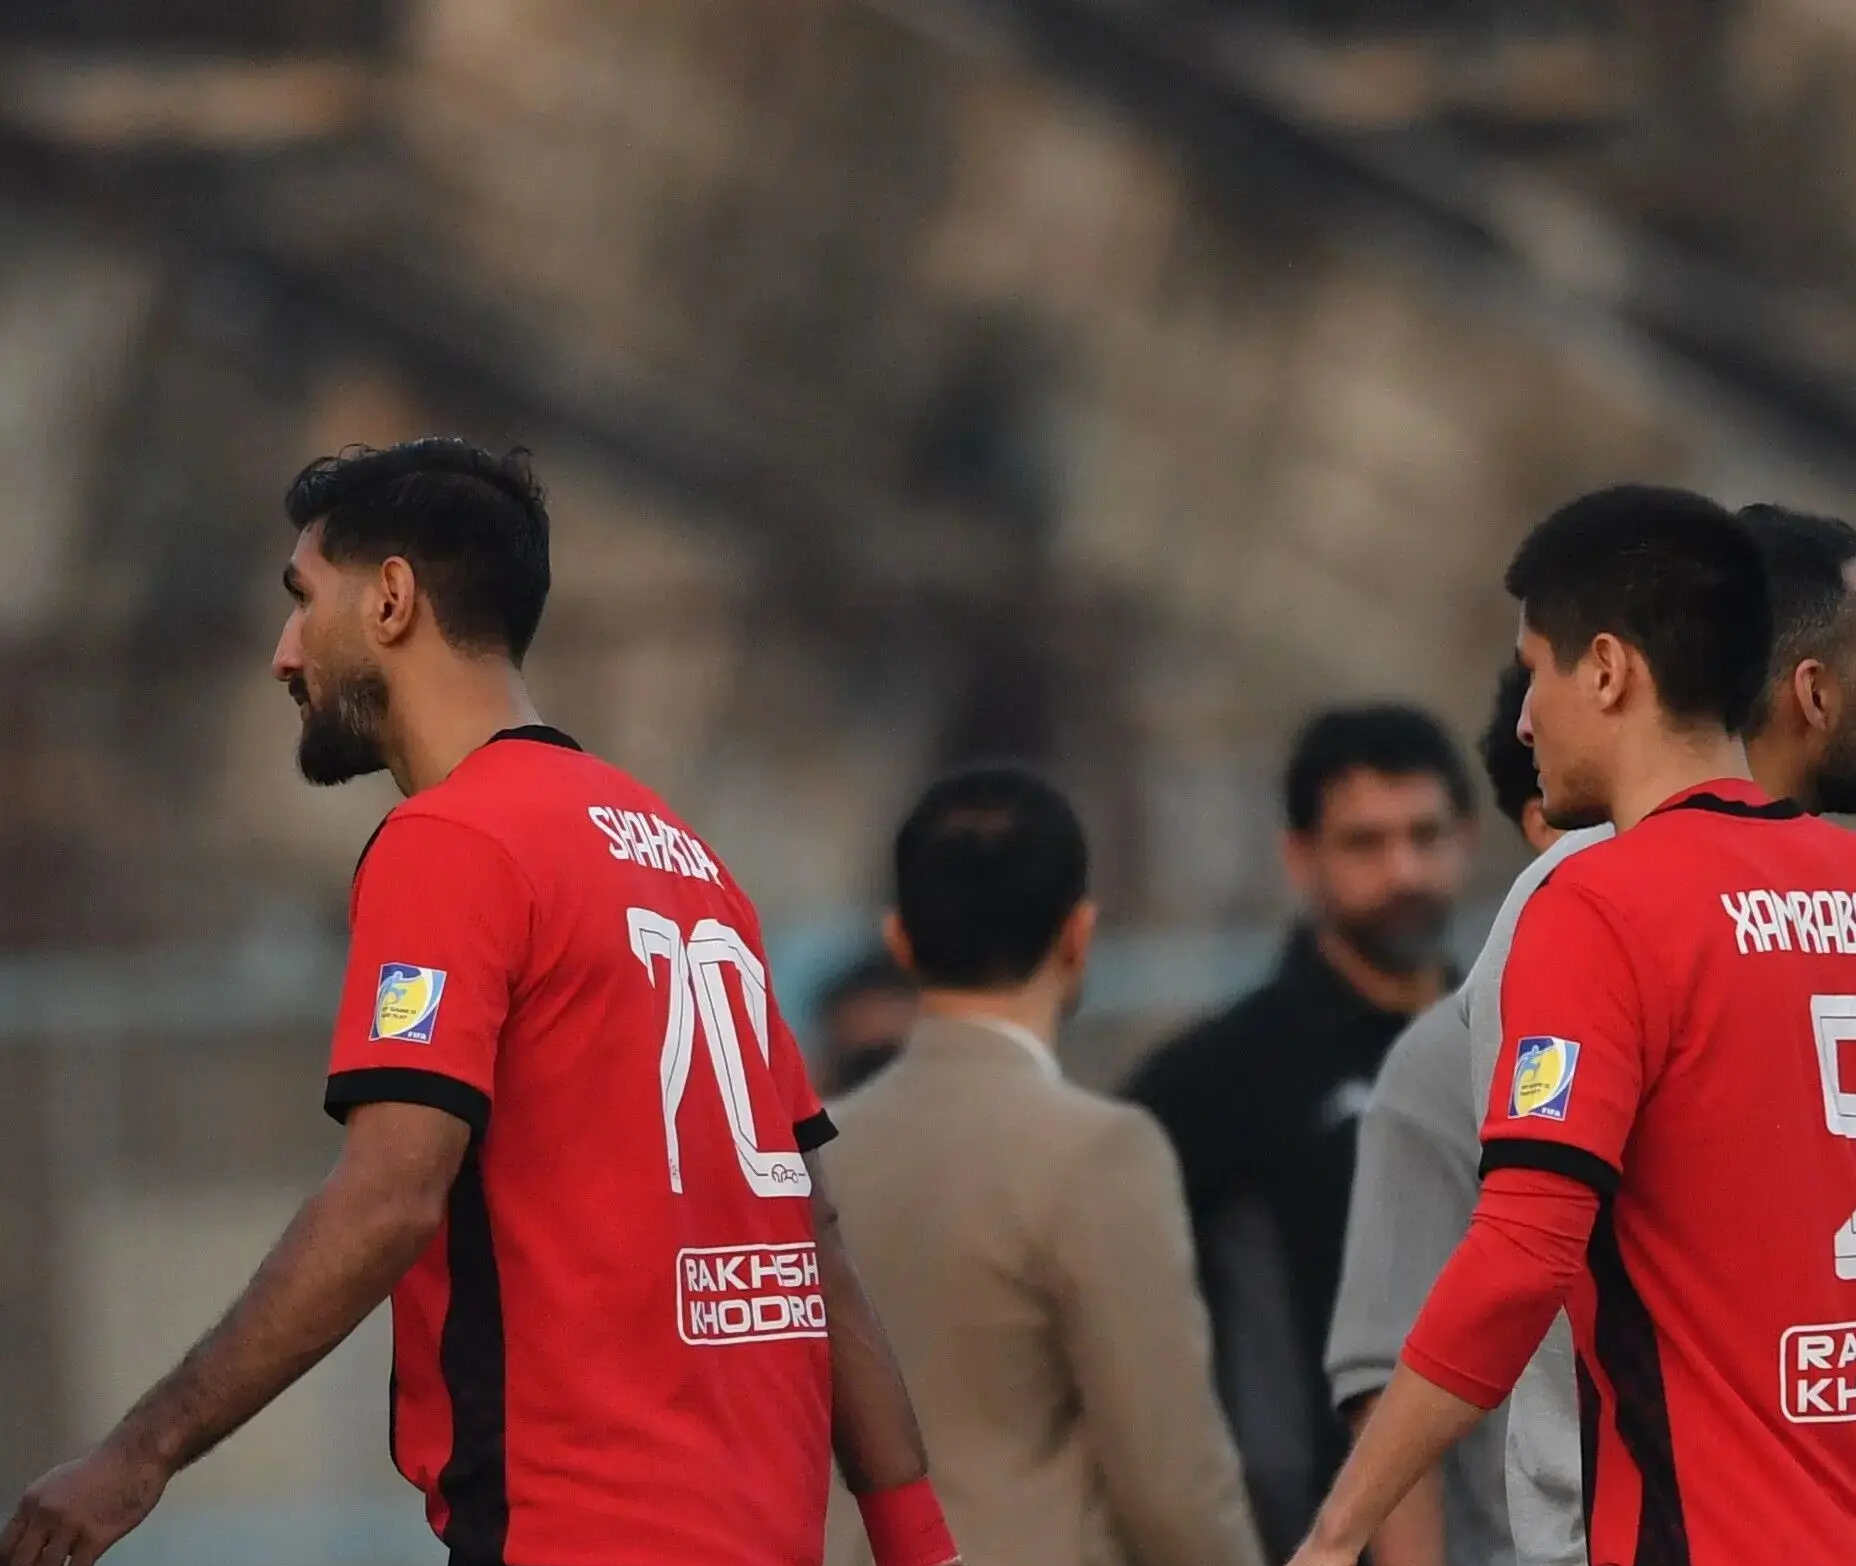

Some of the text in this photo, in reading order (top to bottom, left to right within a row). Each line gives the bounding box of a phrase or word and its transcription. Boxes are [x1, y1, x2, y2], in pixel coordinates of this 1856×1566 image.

[626, 907, 812, 1197] 70
[685, 1252, 820, 1293] RAKHSH
[690, 1295, 827, 1335] KHODRO
